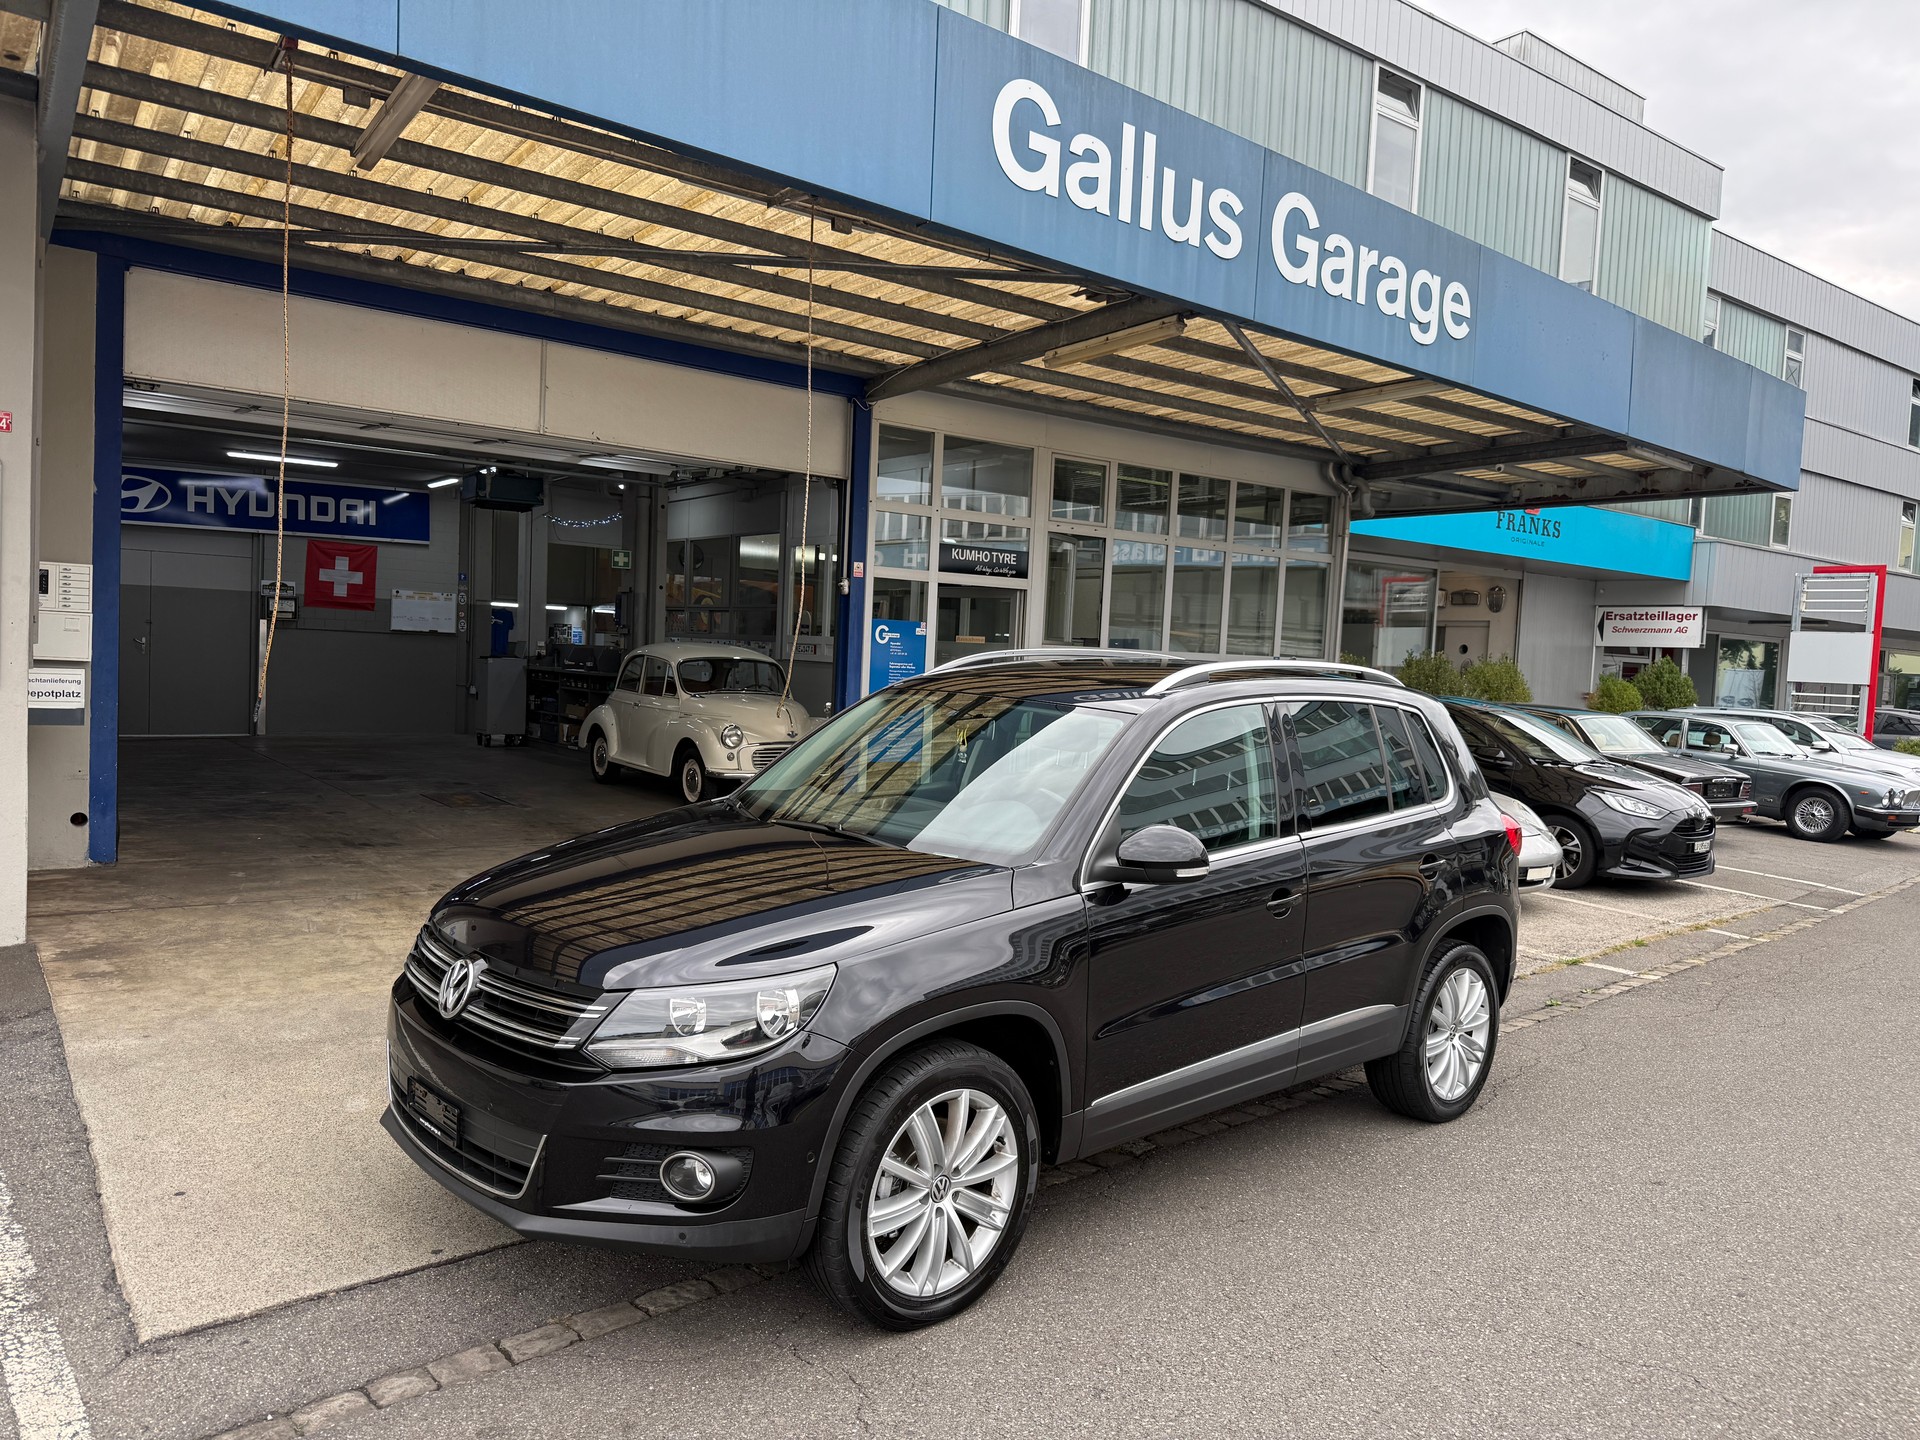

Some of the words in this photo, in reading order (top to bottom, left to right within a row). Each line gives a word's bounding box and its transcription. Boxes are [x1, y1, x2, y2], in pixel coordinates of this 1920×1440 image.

[992, 78, 1244, 260] Gallus
[1271, 191, 1472, 346] Garage
[186, 484, 377, 526] HYUNDAI
[1496, 510, 1561, 539] FRANKS
[1511, 536, 1545, 547] ORIGINALE
[951, 547, 990, 562] KUMHO
[992, 551, 1017, 565] TYRE
[1605, 610, 1699, 623] Ersatzteillager
[1611, 625, 1673, 634] Schwerzmann
[1674, 626, 1689, 634] AG
